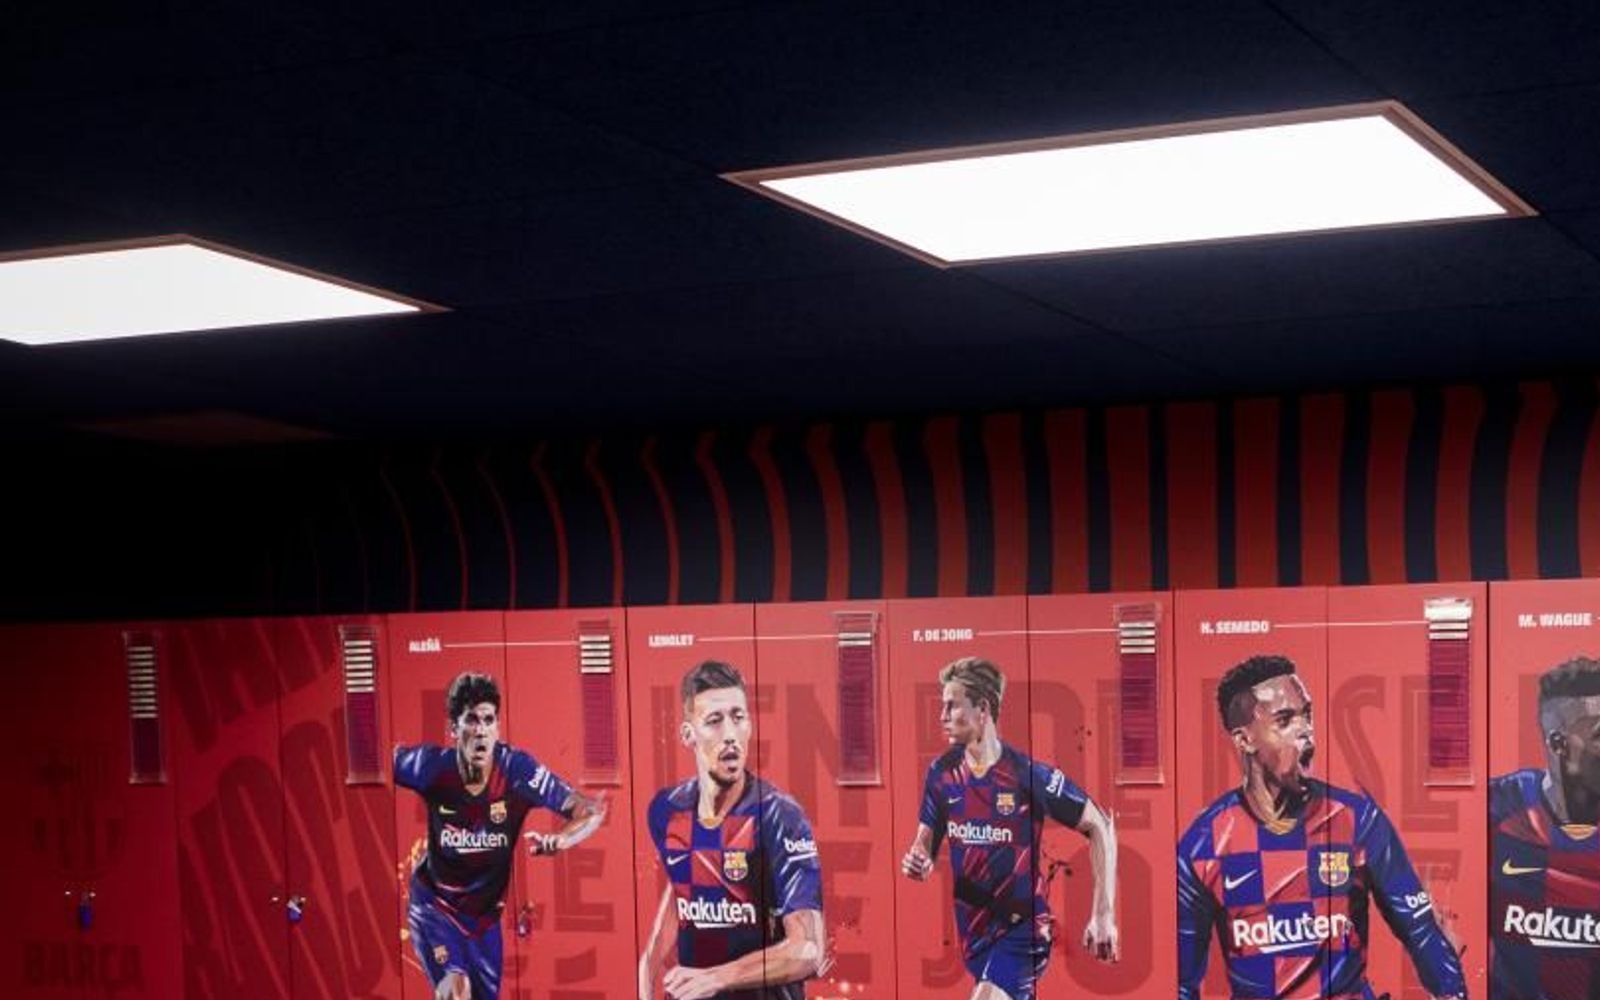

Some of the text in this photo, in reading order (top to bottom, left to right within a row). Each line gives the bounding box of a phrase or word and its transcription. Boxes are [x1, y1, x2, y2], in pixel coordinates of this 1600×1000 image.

[1215, 620, 1269, 634] SEMEDO
[1518, 612, 1592, 627] M. WAGUE
[440, 828, 508, 849] Rakuten
[947, 821, 1012, 842] Rakuten
[677, 896, 756, 924] Rakuten
[1233, 910, 1348, 947] Rakuten
